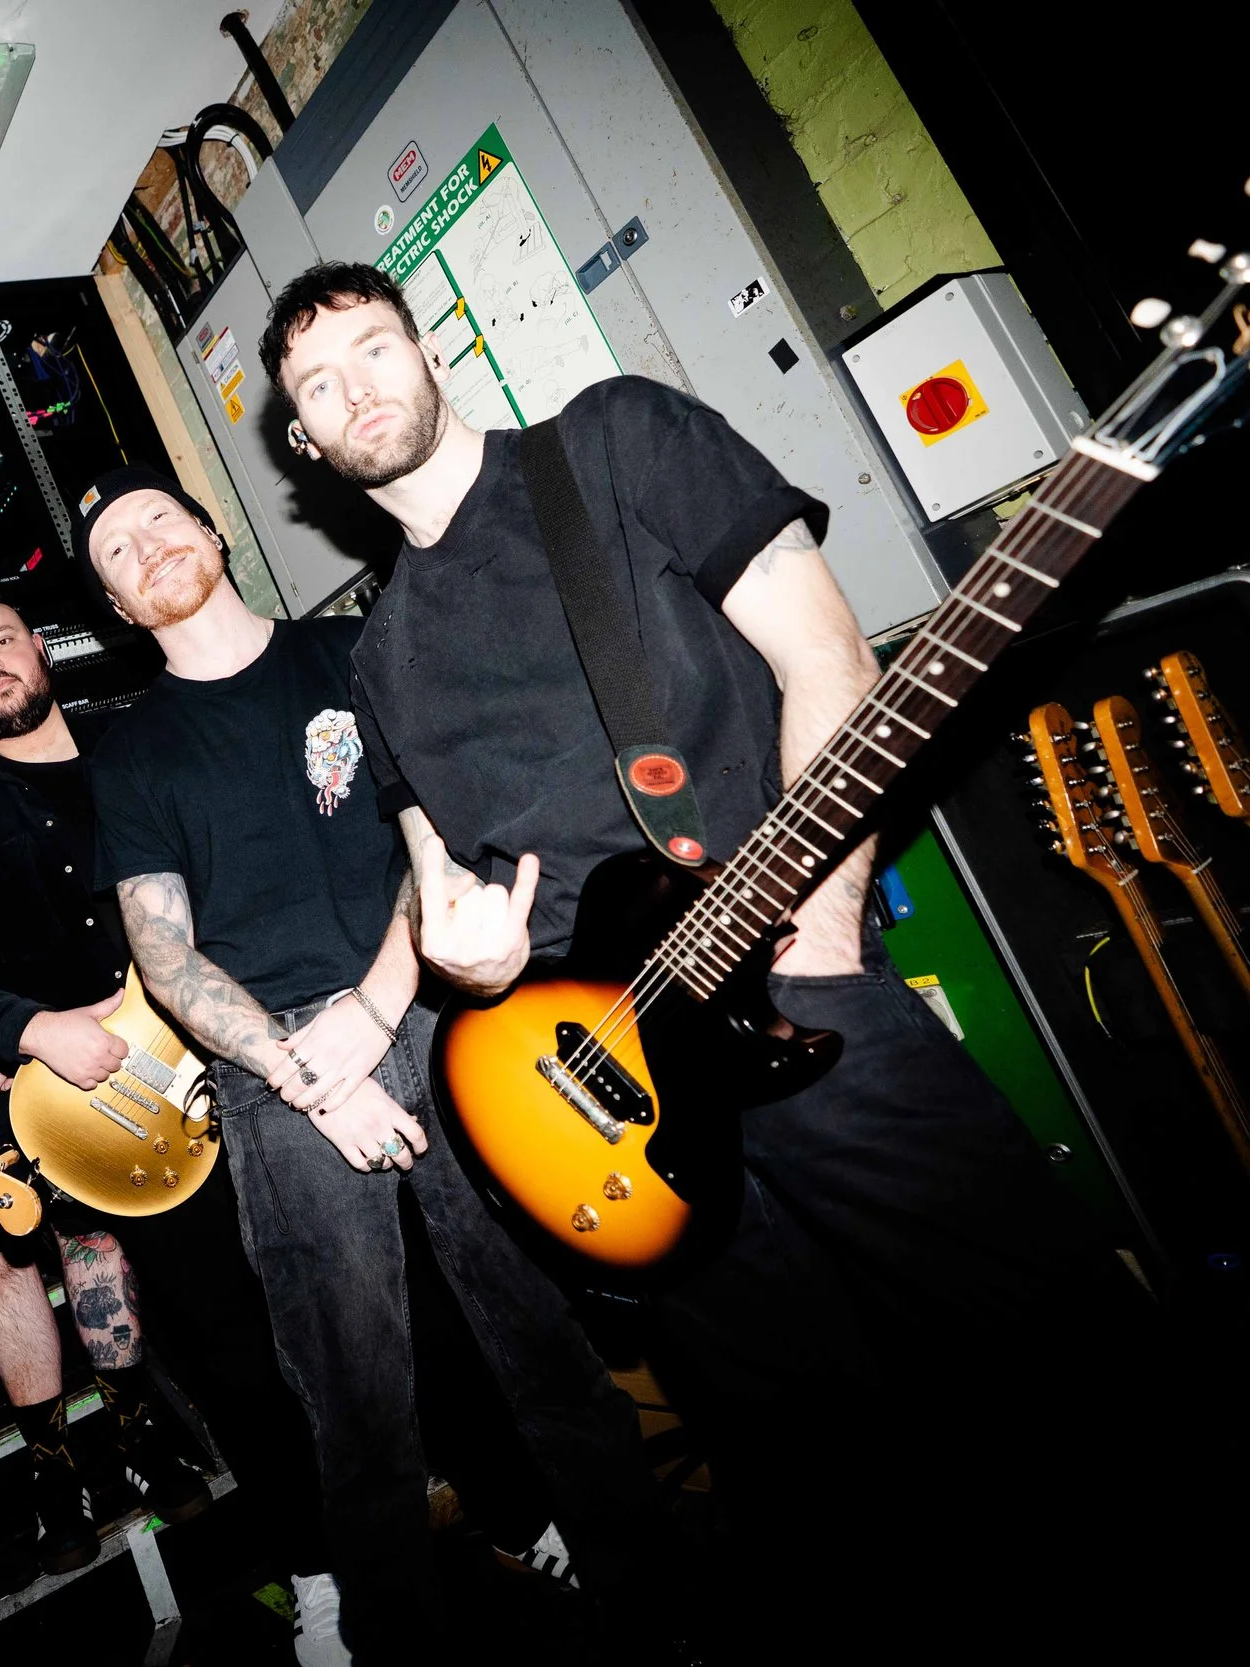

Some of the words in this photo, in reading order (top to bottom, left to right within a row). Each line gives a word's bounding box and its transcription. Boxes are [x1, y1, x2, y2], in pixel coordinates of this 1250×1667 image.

[393, 151, 416, 181] MEM
[400, 165, 423, 194] MEMSHIELD
[376, 197, 439, 273] REATMENT
[439, 163, 471, 202] FOR
[391, 231, 432, 280] ECTRIC
[431, 177, 479, 235] SHOCK
